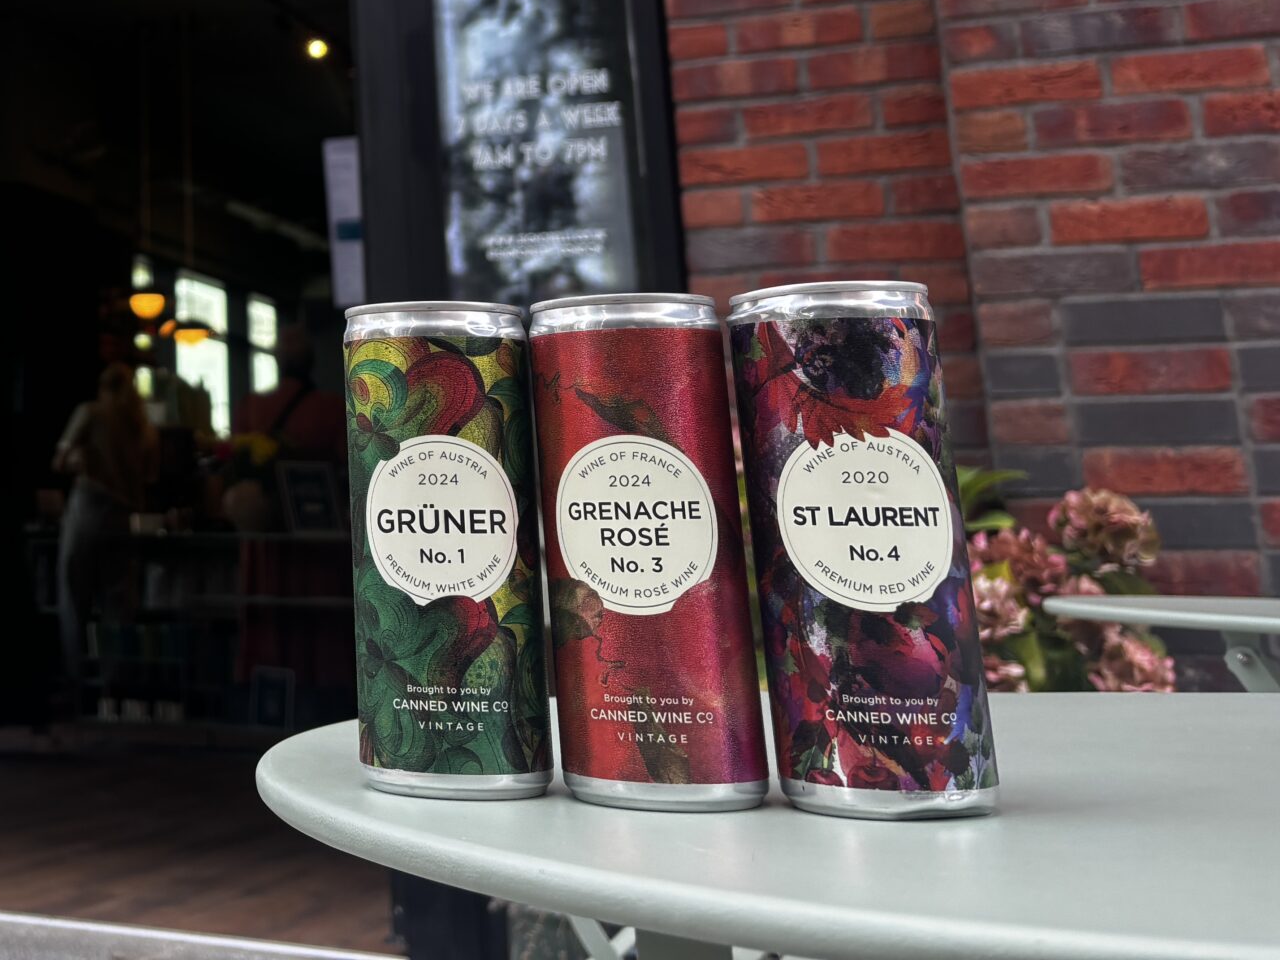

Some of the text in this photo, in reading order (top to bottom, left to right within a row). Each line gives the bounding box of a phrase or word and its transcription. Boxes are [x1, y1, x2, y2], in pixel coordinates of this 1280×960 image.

[547, 69, 608, 95] OPEN
[560, 102, 620, 128] WEEK
[388, 451, 488, 479] WINE OF AUSTRIA
[578, 452, 683, 479] WINE OF FRANCE
[803, 442, 921, 475] WINE OF AUSTRIA
[418, 474, 459, 485] 2024
[609, 475, 652, 487] 2024
[842, 471, 889, 484] 2020
[568, 501, 701, 520] GRENACHE
[793, 506, 940, 527] ST LAURENT
[377, 504, 507, 534] GRÜNER
[600, 523, 670, 546] ROSÉ
[420, 548, 465, 564] No. 1
[610, 557, 664, 573] No. 3
[386, 554, 502, 593] PREMIUM WHITE WINE
[580, 561, 699, 598] PREMIUM ROSÉ WINE
[814, 560, 935, 595] PREMIUM RED WINE
[407, 684, 491, 696] Brought to you by
[393, 698, 448, 712] CANNED
[451, 701, 489, 713] WINE
[604, 693, 694, 706] Brought to you by
[842, 694, 939, 707] Brought to you by
[590, 708, 648, 723] CANNED
[652, 711, 693, 724] WINE
[825, 709, 892, 724] CANNED
[895, 712, 938, 725] WINE
[418, 721, 485, 732] VINTAGE
[618, 732, 688, 744] VINTAGE
[858, 734, 934, 746] VINTAGE
